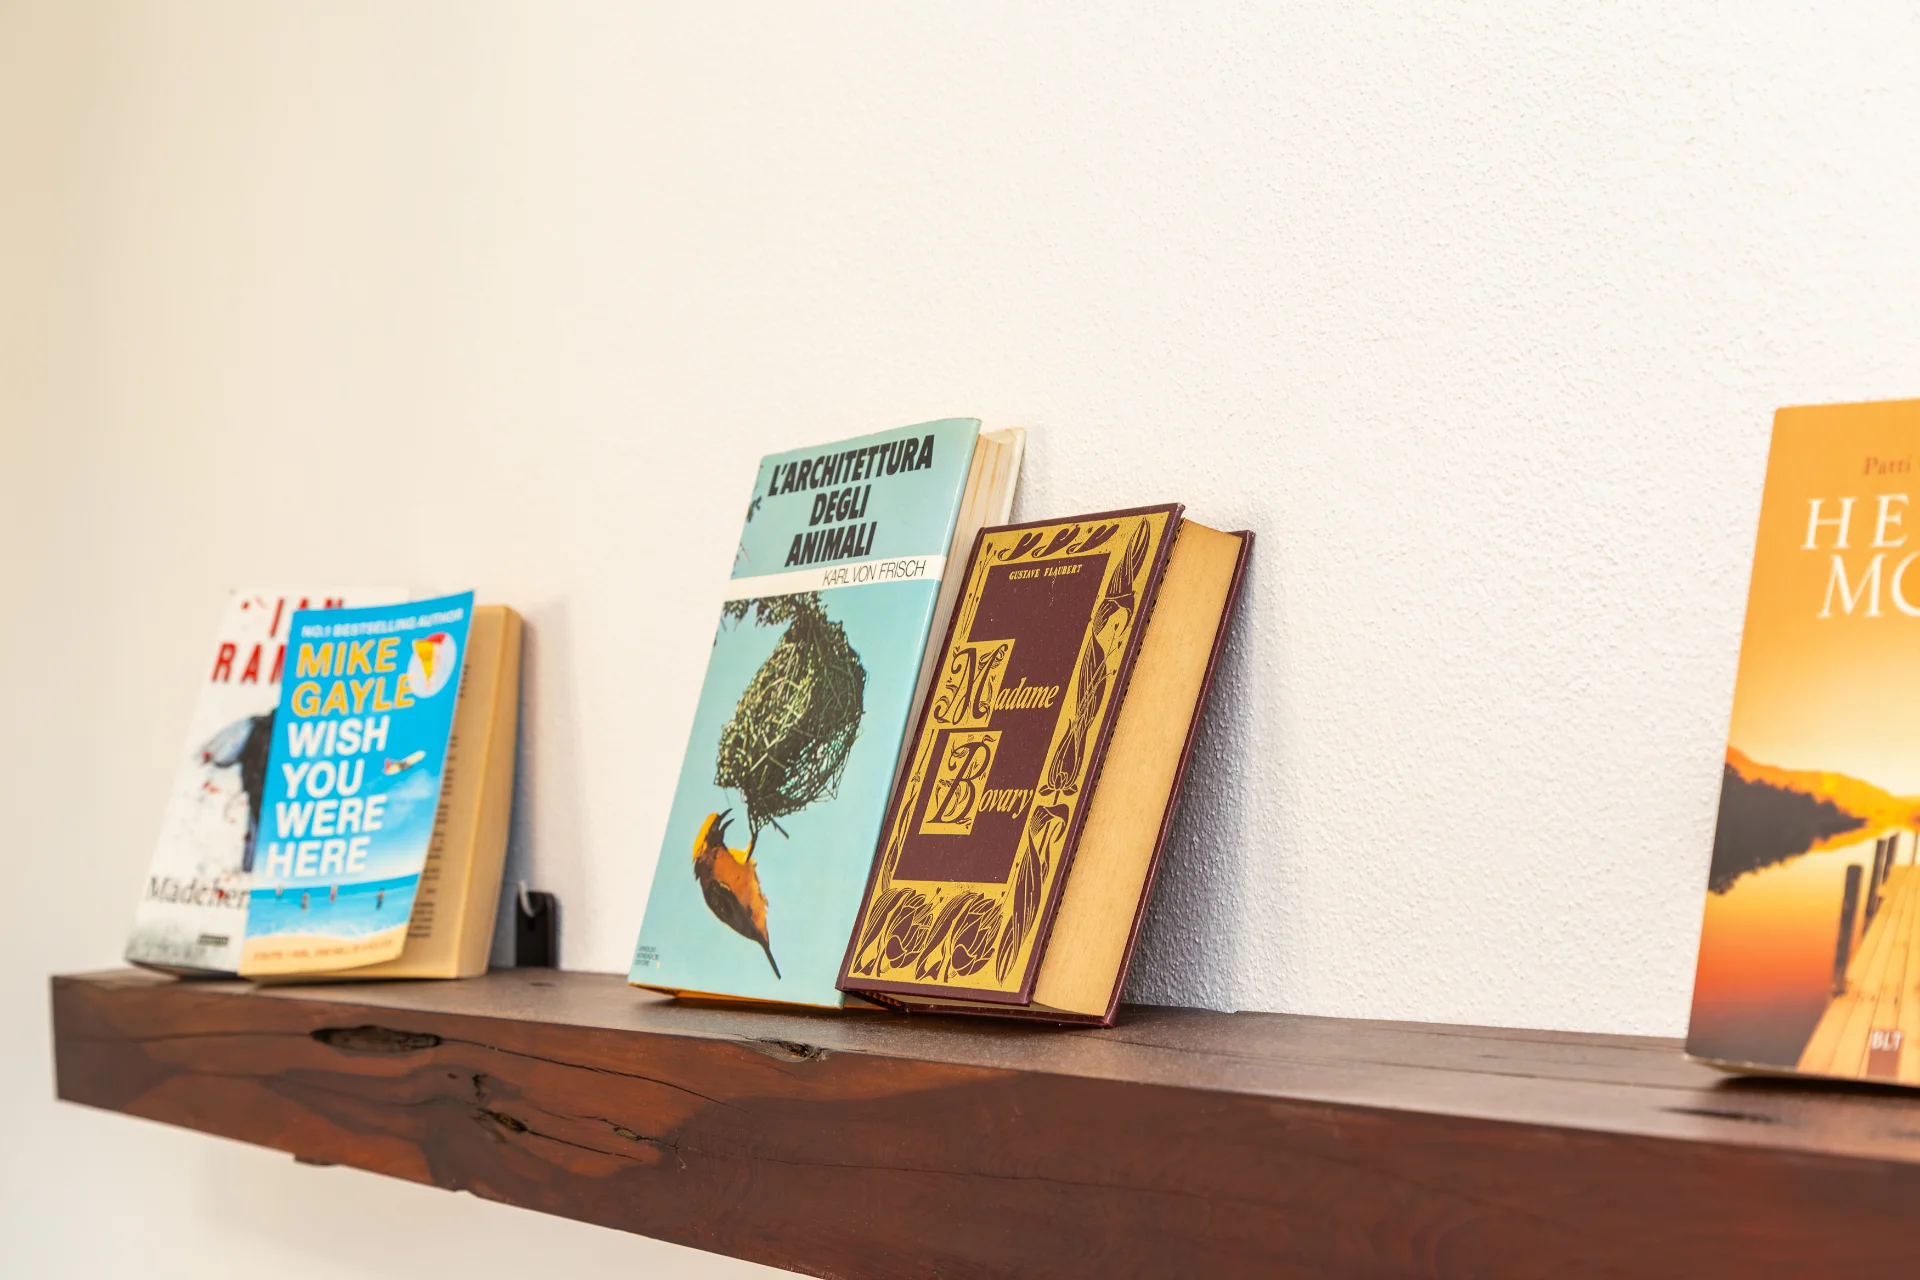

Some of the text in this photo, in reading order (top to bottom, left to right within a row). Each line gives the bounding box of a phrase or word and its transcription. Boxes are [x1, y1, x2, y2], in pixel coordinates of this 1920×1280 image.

[767, 434, 935, 497] L'ARCHITETTURA
[1864, 455, 1911, 475] Patti
[808, 484, 872, 527] DEGLI
[784, 521, 877, 567] ANIMALI
[822, 559, 926, 586] KARL VON FRISCH
[1008, 564, 1082, 581] GUSTAVE FLAUBERT
[332, 616, 417, 637] BESTSELLING
[417, 608, 464, 627] AUTHOR
[296, 637, 401, 678] MIKE
[291, 673, 417, 717] GAYLE
[933, 643, 1060, 725] Madame
[287, 715, 391, 758] WISH
[281, 758, 365, 799] YOU
[925, 740, 1034, 823] Bovary
[275, 794, 388, 839] WERE
[265, 836, 371, 878] HERE
